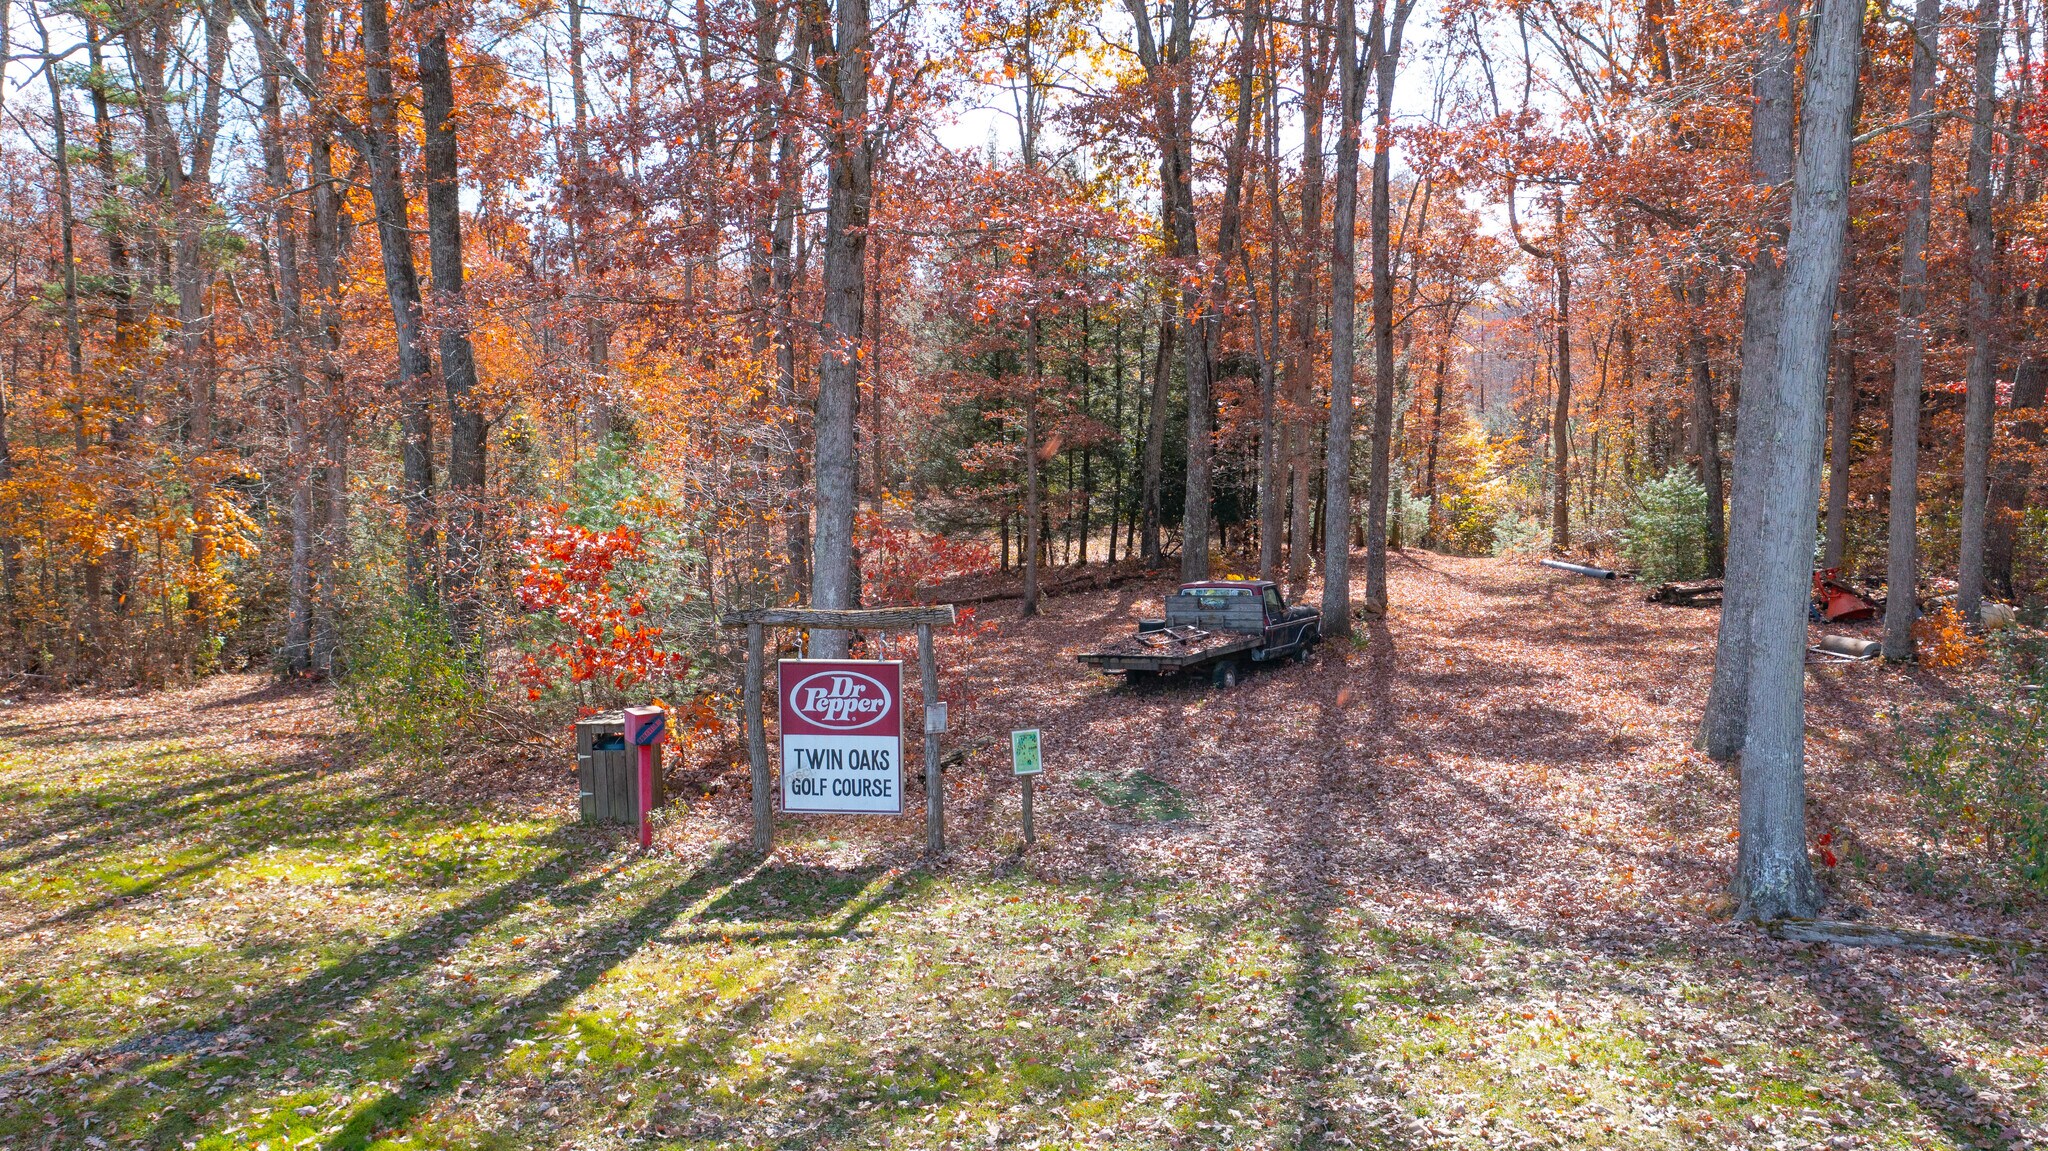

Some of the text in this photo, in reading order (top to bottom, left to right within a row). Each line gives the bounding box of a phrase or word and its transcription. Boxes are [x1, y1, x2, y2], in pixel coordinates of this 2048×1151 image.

[827, 676, 866, 698] Dr
[801, 687, 884, 721] Pepper
[794, 748, 890, 771] TWIN OAKS
[791, 777, 892, 798] GOLF COURSE
